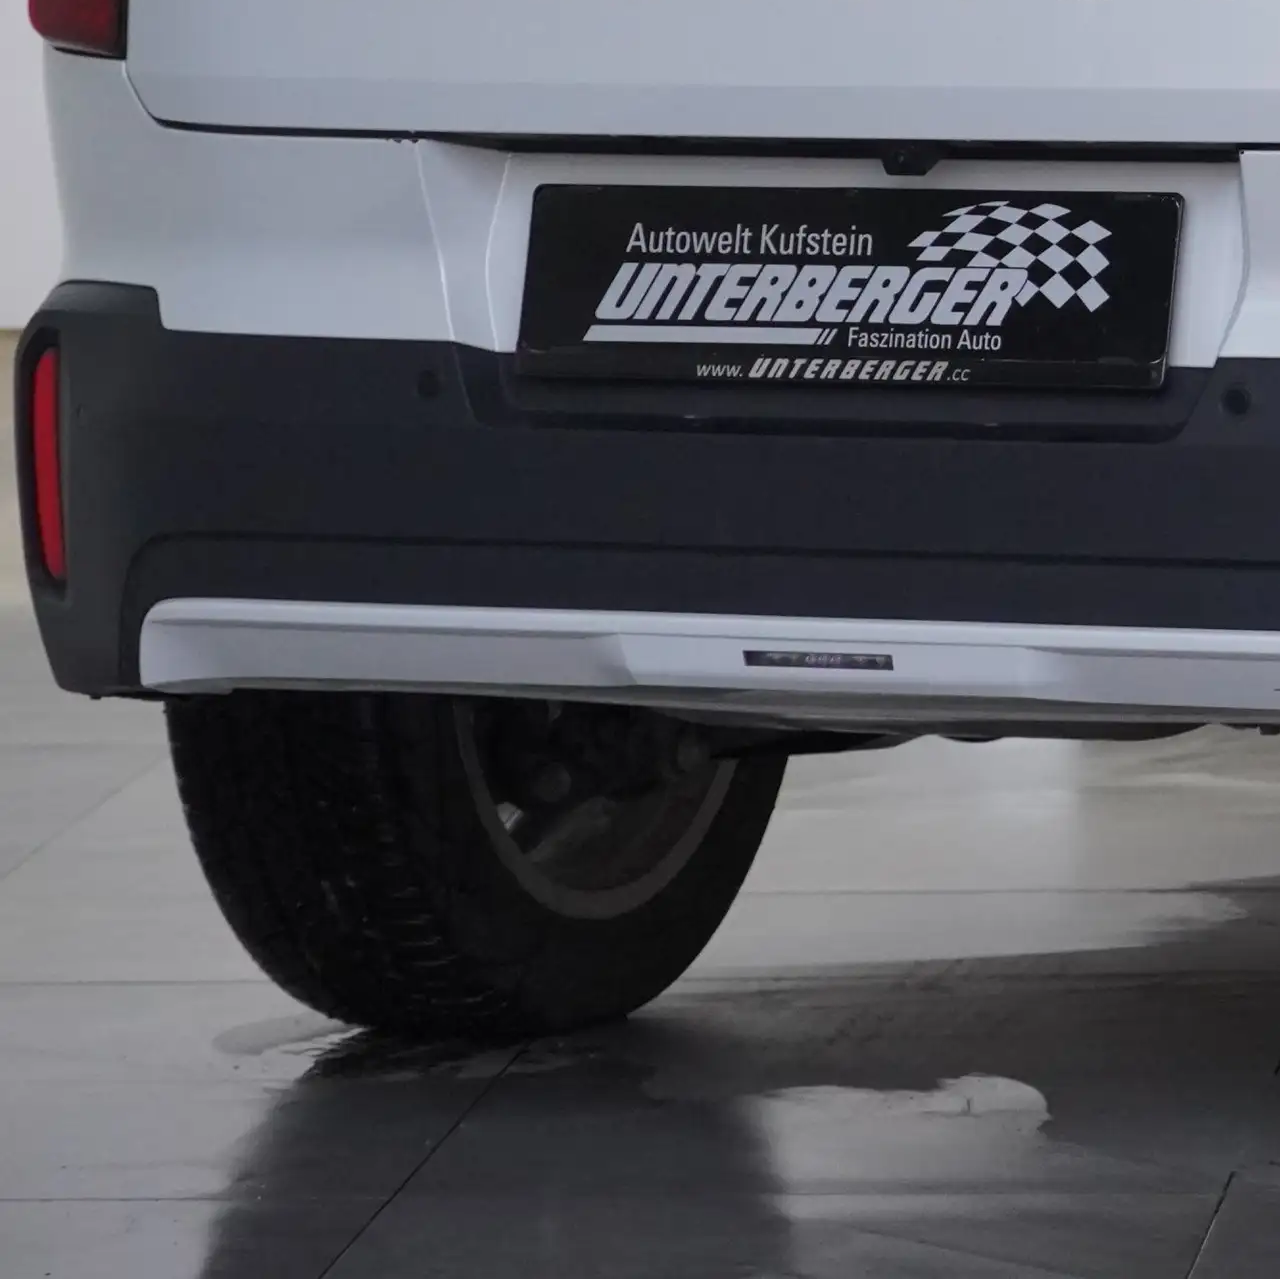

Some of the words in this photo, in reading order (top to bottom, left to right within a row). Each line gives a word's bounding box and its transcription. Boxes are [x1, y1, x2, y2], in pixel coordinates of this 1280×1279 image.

[625, 222, 752, 255] Autowelt
[760, 223, 874, 256] Kufstein
[594, 262, 1029, 327] UNTERBERGER
[847, 326, 952, 350] Faszination
[956, 328, 1002, 352] Auto
